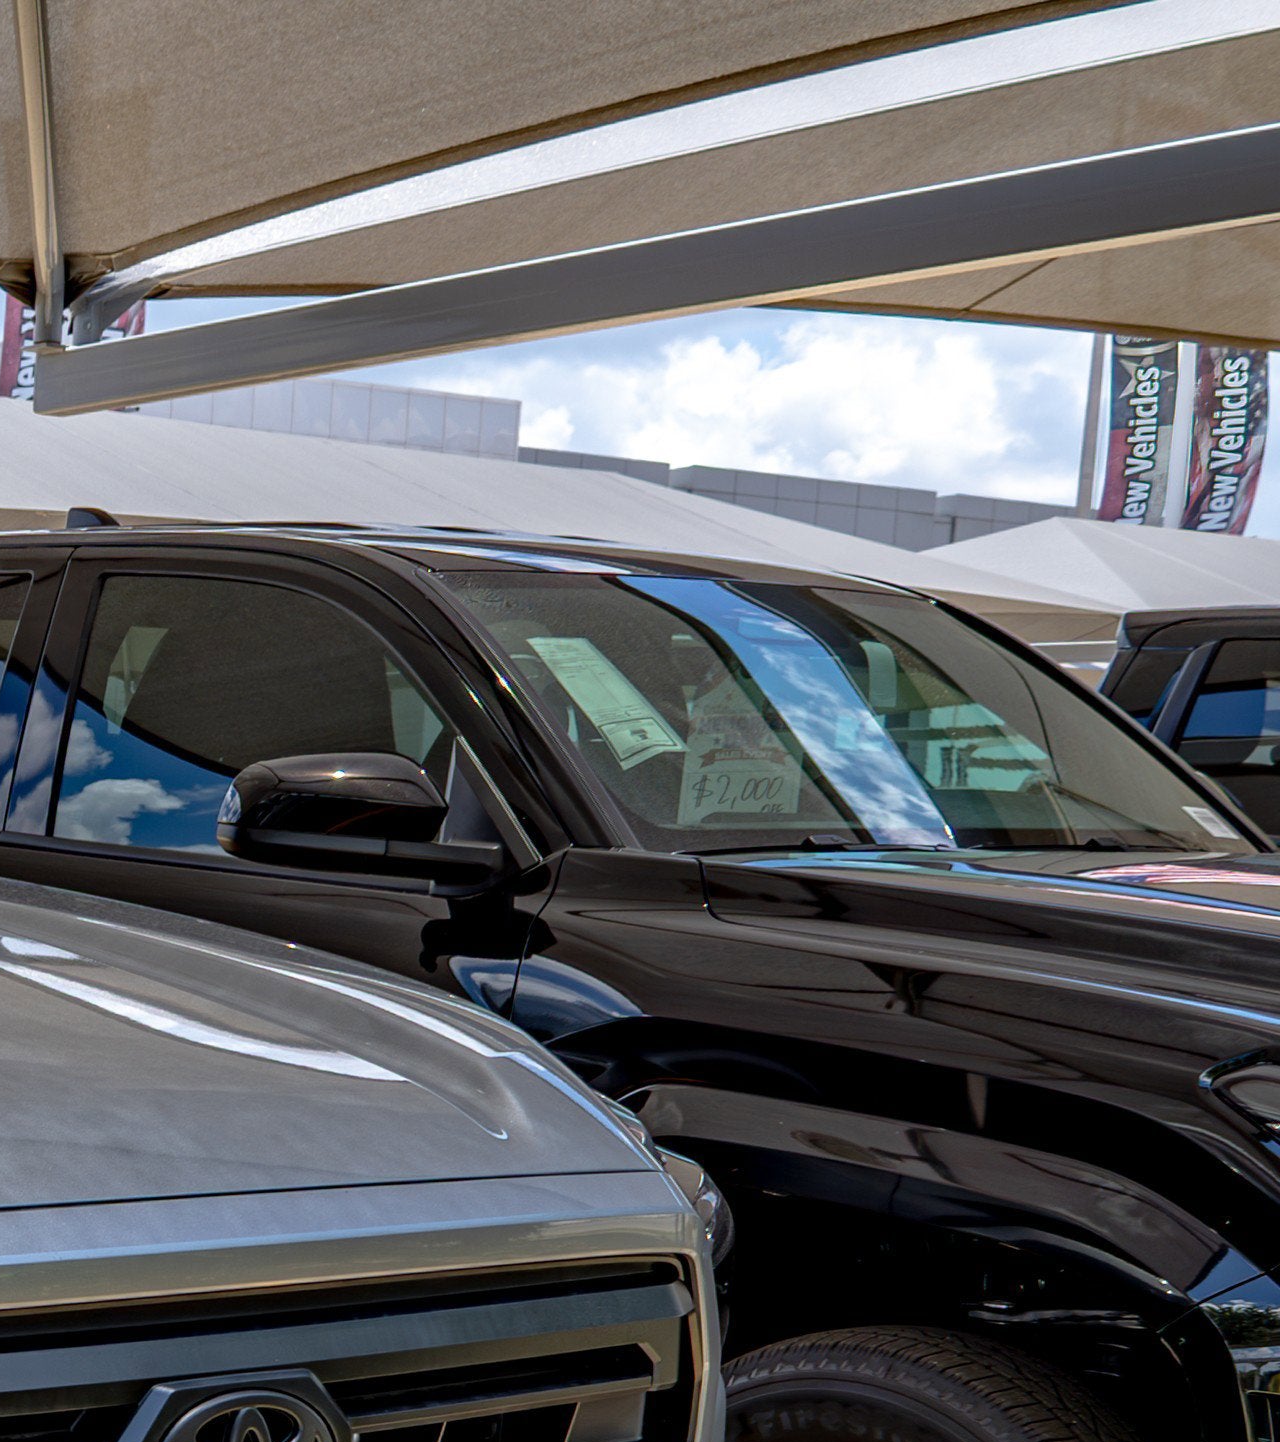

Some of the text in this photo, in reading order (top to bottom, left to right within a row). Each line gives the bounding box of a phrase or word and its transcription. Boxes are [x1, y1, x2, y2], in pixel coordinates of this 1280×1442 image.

[1124, 366, 1161, 477] Vehicles
[1197, 356, 1250, 531] New Vehicles
[692, 774, 784, 809] $2,000
